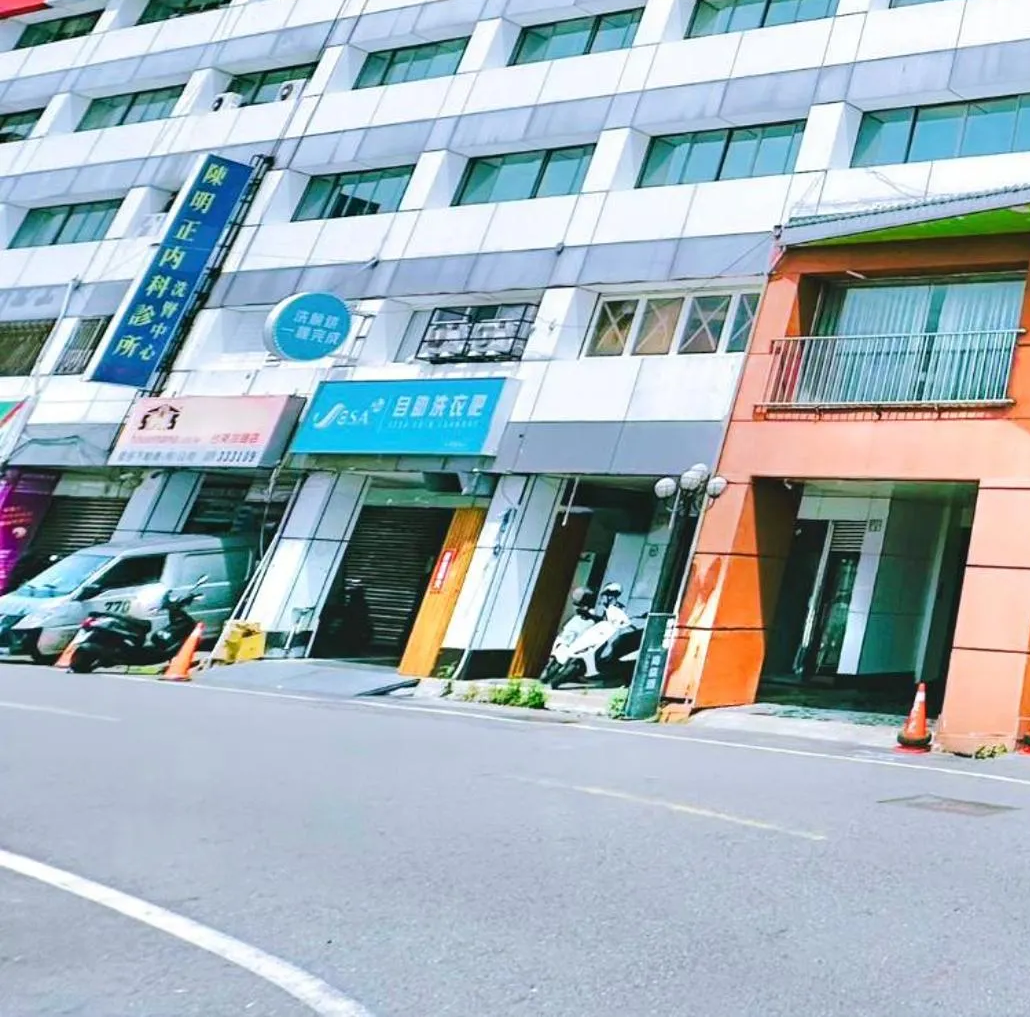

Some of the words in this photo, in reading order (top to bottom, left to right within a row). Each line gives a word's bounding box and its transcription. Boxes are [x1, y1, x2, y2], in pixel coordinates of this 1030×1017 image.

[111, 163, 229, 359] 陳明正內科診所
